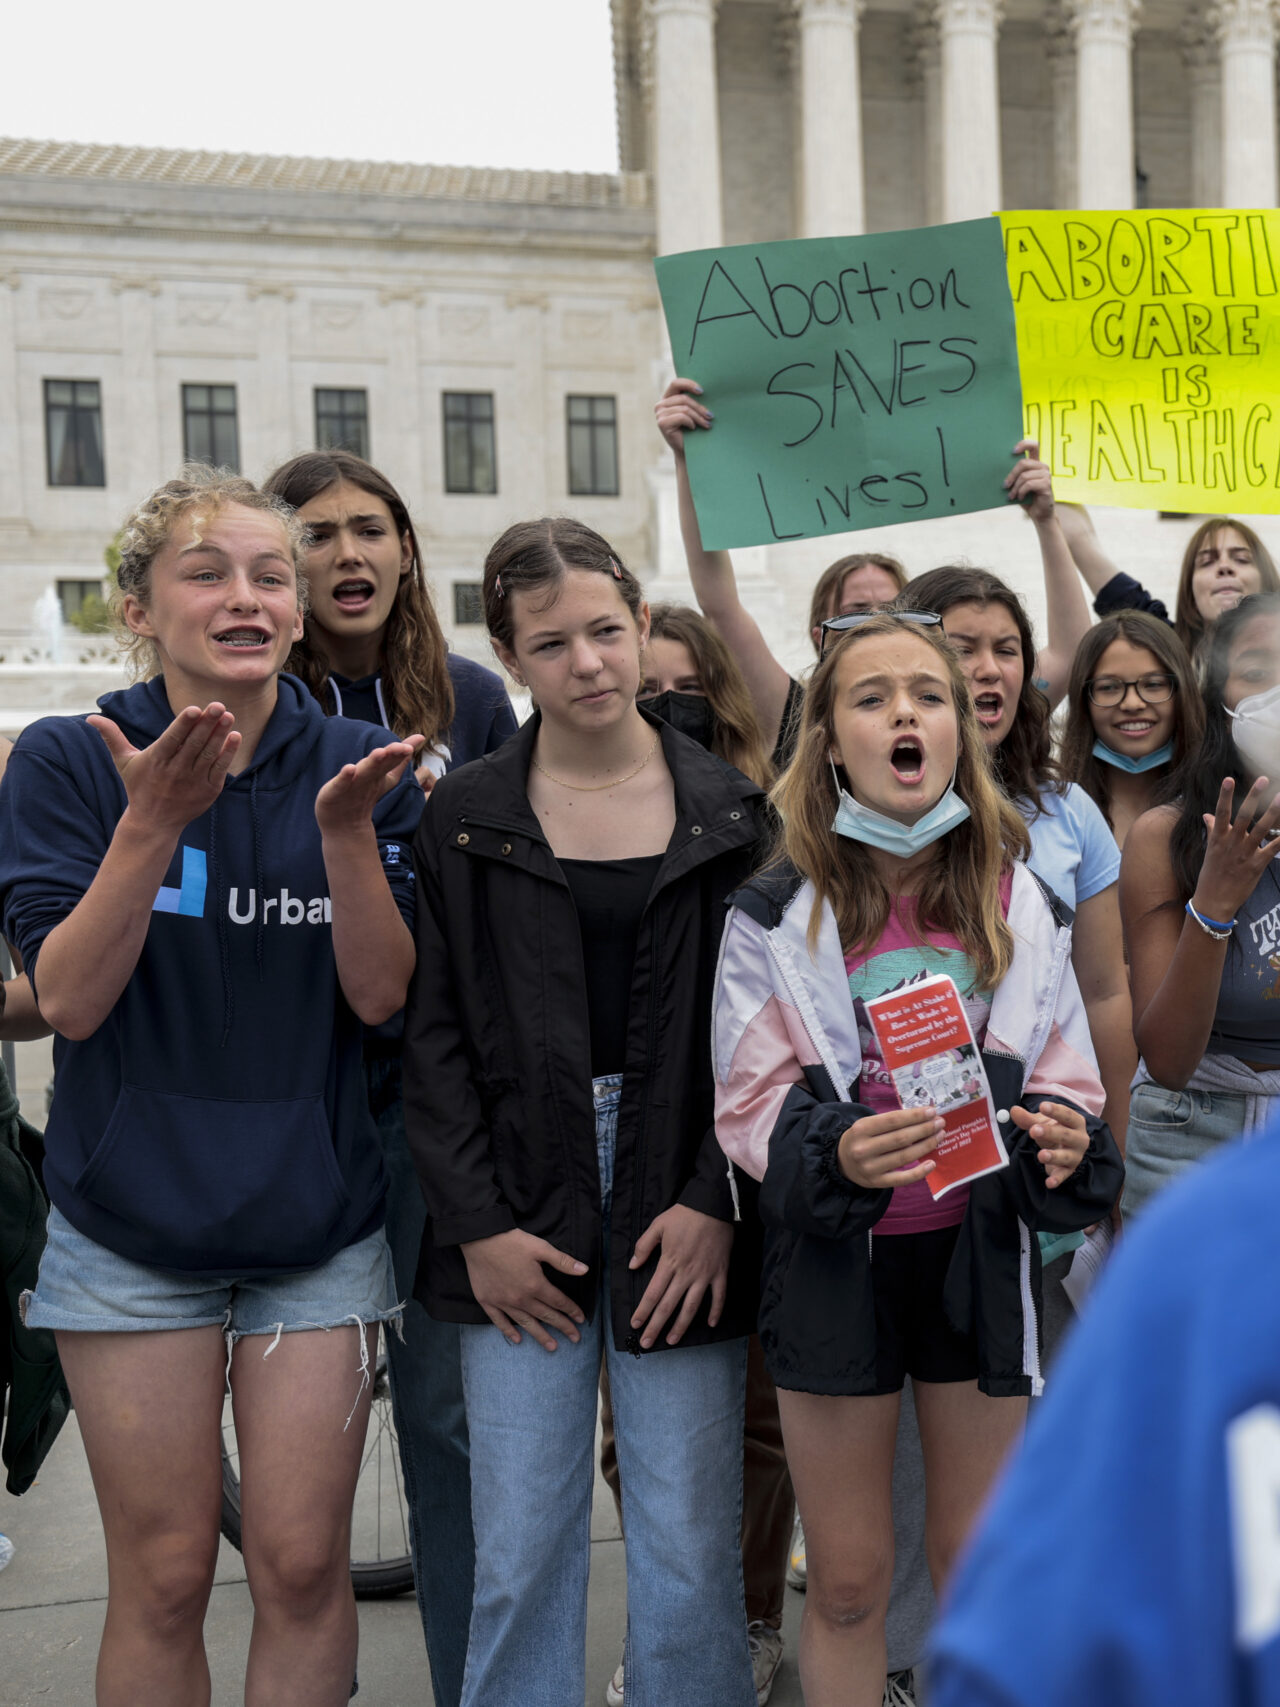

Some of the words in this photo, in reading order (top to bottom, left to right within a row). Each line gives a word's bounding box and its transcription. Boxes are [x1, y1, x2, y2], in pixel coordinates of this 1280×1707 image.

[688, 256, 971, 358] Abortion
[1091, 300, 1261, 360] CARE
[766, 338, 978, 447] SAVES
[1161, 364, 1212, 408] IS
[757, 426, 956, 540] Lives!
[877, 1010, 902, 1021] What
[922, 995, 946, 1006] Stake
[887, 1022, 934, 1044] Overturned
[944, 1015, 959, 1024] the
[890, 1021, 908, 1030] Roe
[916, 1008, 940, 1020] Wade
[895, 1038, 931, 1055] Supreme
[931, 1025, 958, 1041] Court?
